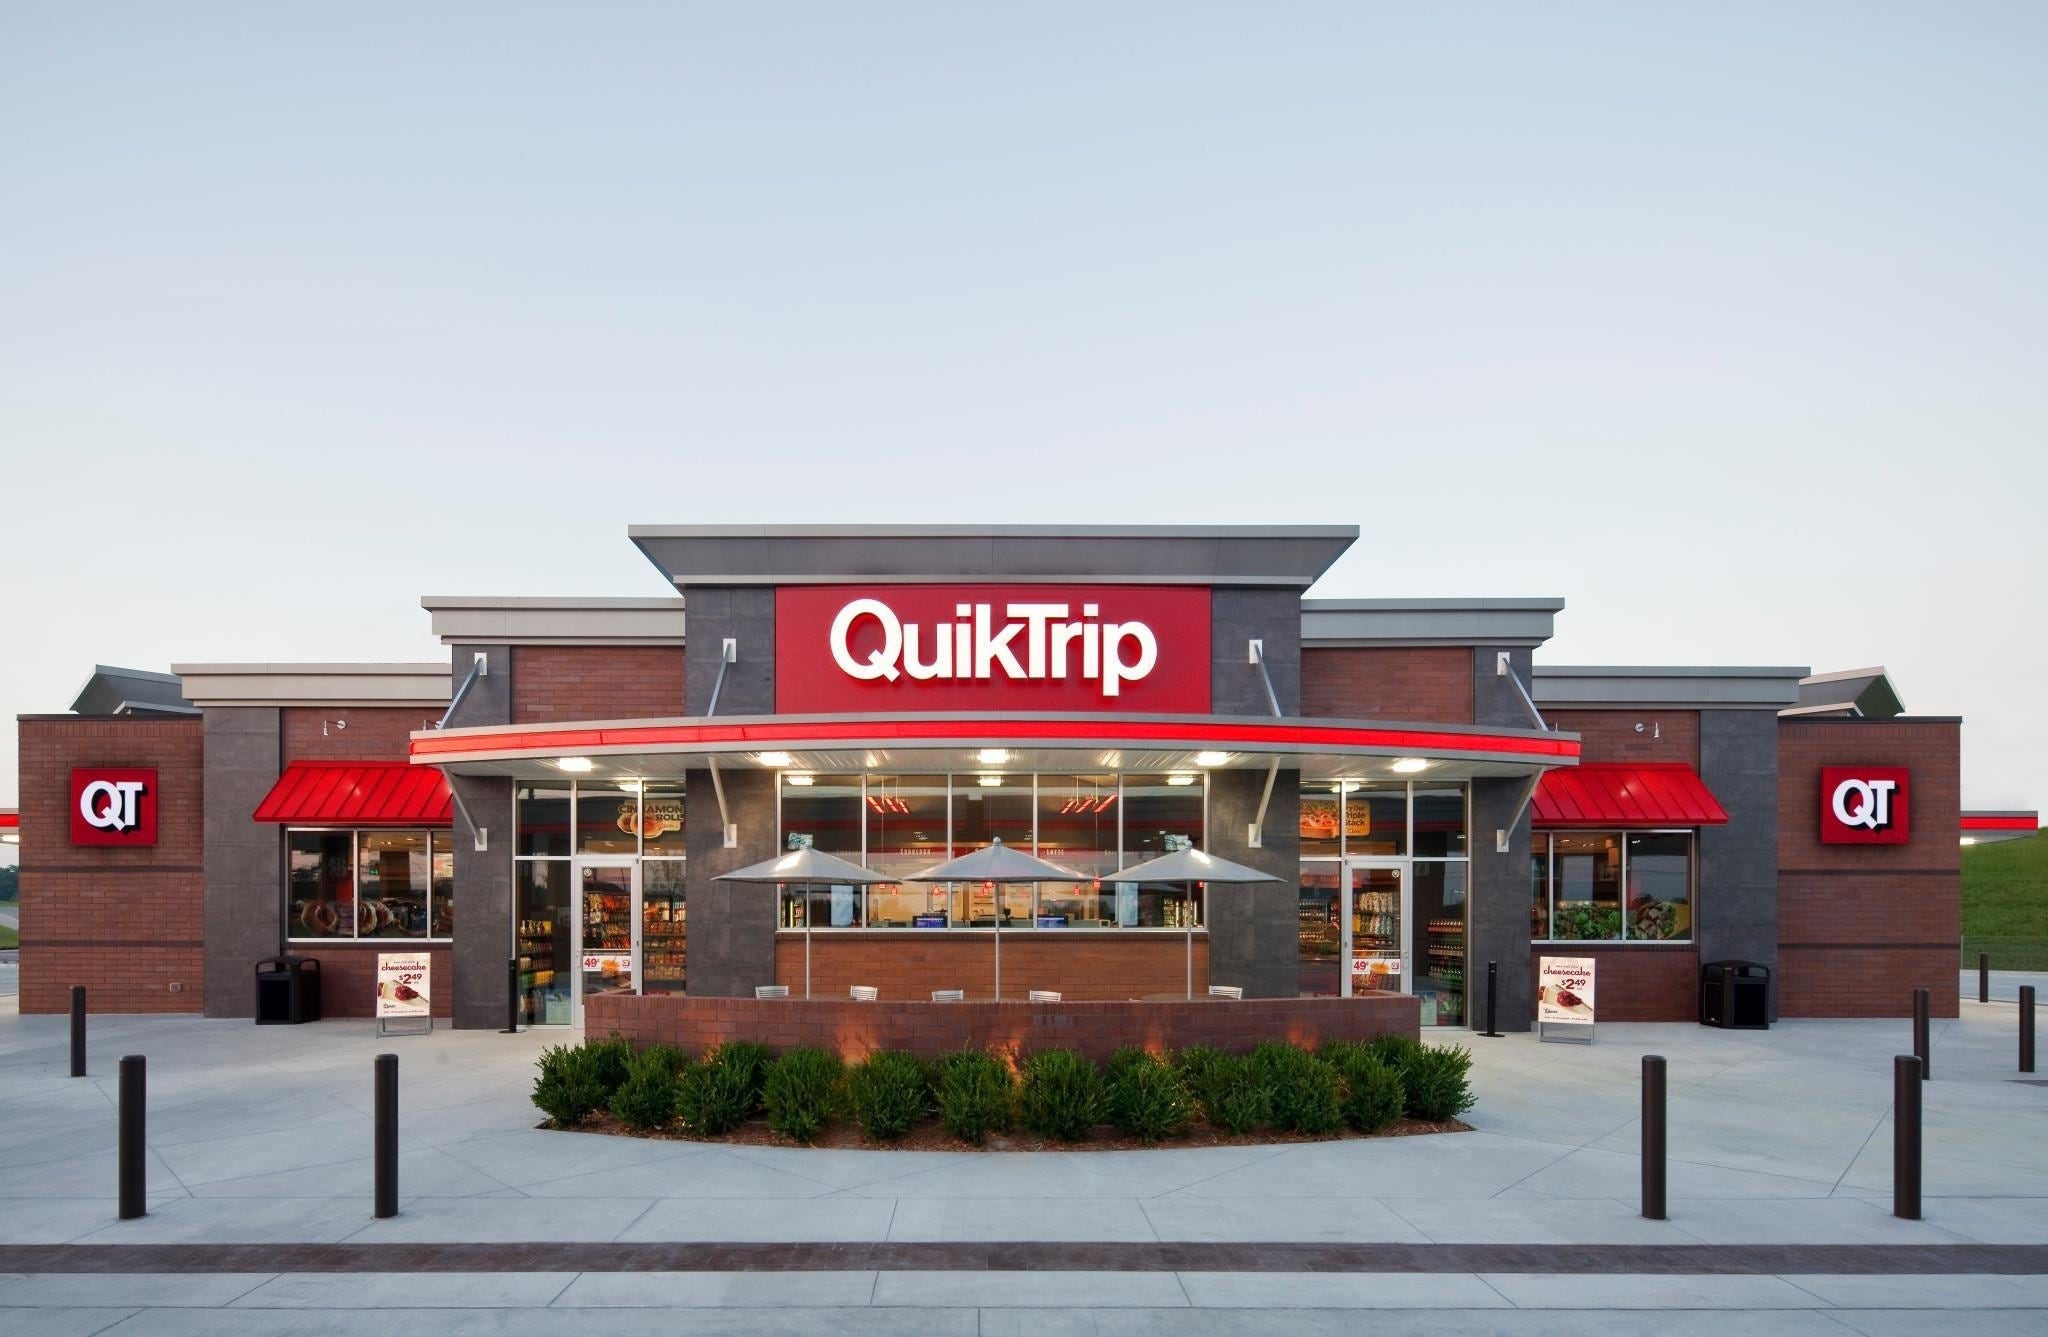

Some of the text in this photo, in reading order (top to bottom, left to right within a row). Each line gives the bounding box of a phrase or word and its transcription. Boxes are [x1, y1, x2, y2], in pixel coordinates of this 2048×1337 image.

[830, 598, 1158, 697] QuikTrip
[80, 780, 143, 831] QT
[619, 805, 683, 814] CINAMON
[1832, 779, 1895, 829] QT
[382, 962, 426, 971] cheesecake
[1543, 966, 1591, 976] cheesecake
